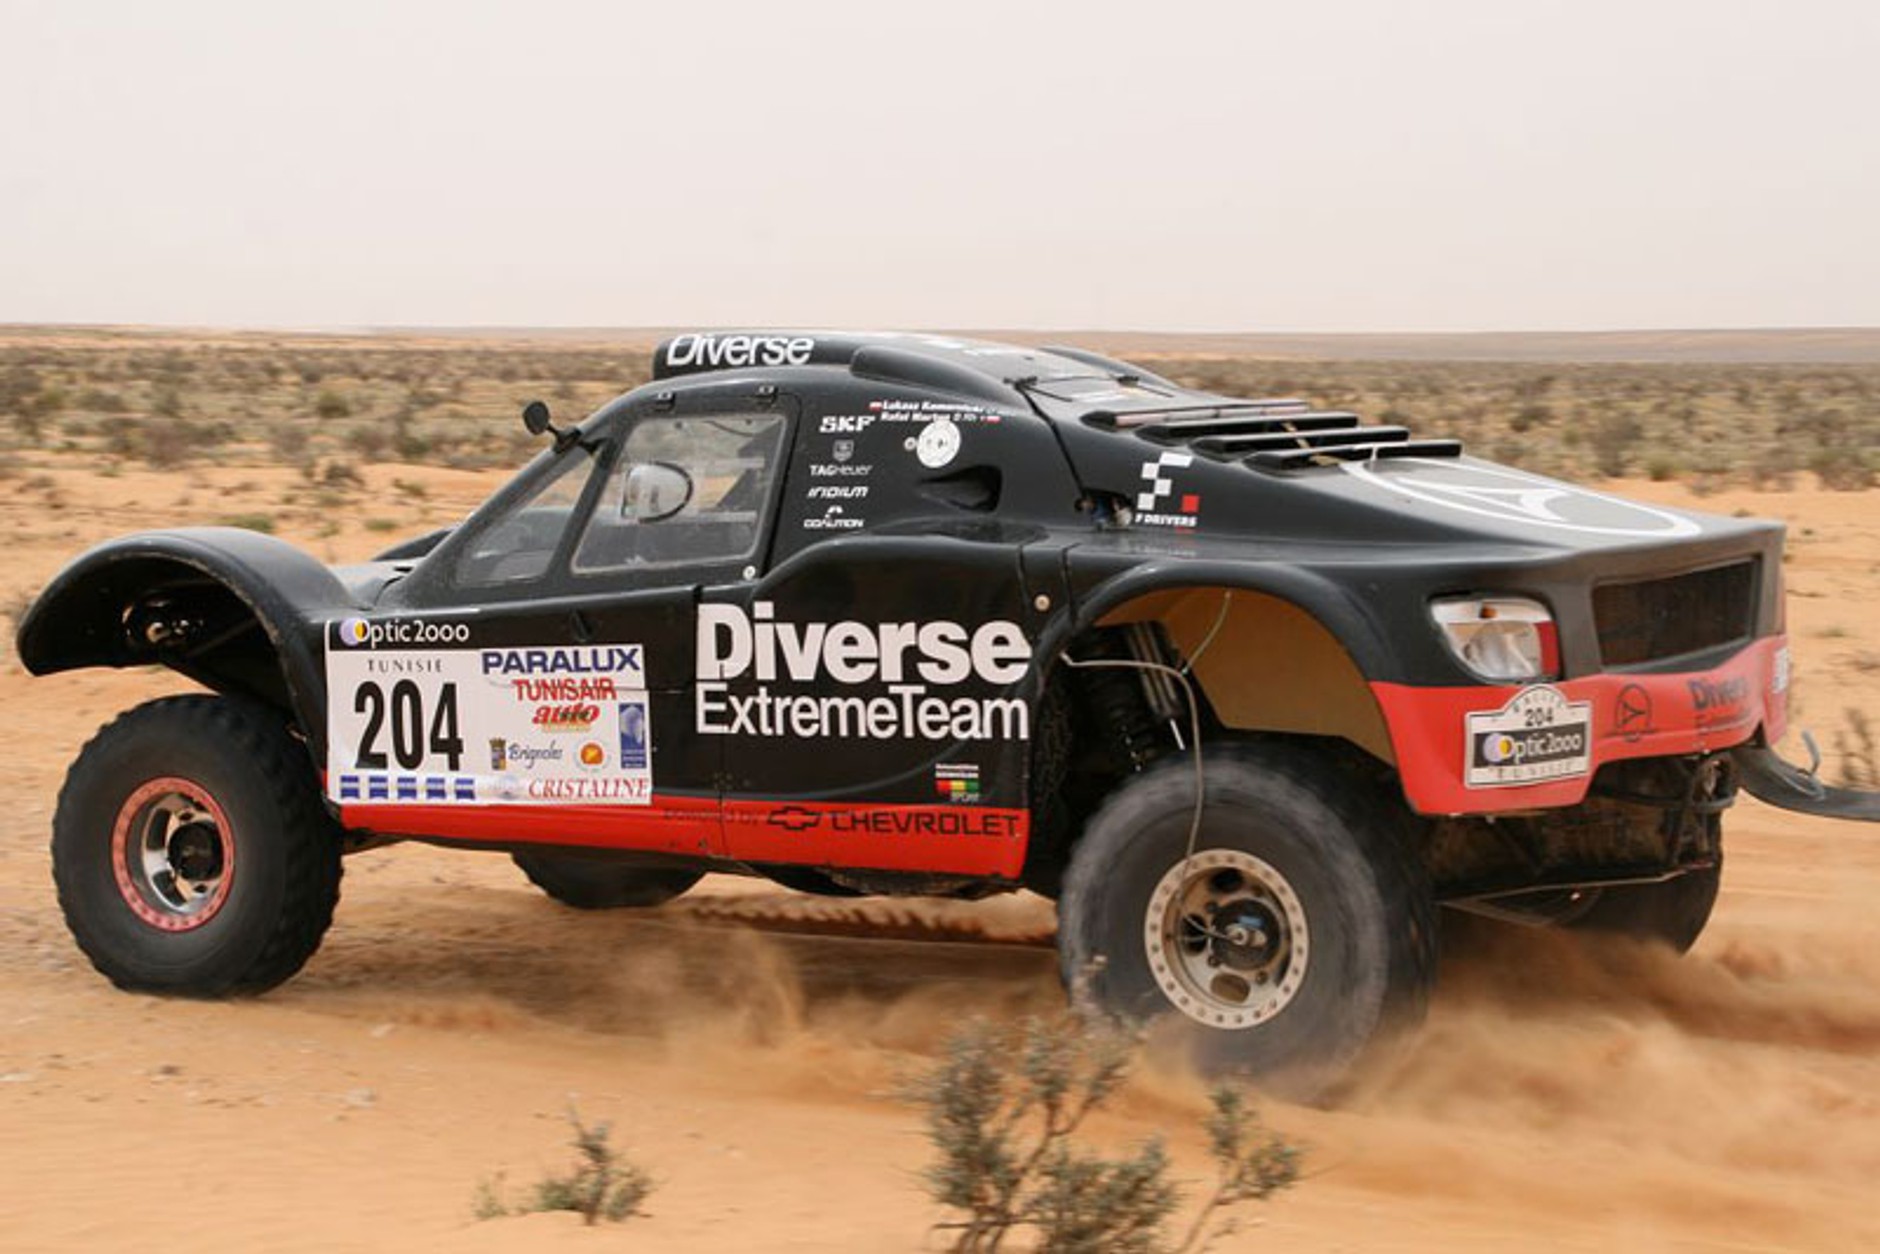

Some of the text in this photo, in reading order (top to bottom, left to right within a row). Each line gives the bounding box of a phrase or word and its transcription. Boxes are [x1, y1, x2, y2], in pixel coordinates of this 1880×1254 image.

[666, 334, 814, 367] Diverse
[820, 415, 876, 433] SKF
[1144, 513, 1197, 527] DRIVERS
[697, 601, 1033, 684] Diverse
[368, 659, 443, 673] TUNISIE
[482, 648, 640, 675] PARALUX
[511, 678, 618, 701] TUNISAIR
[696, 682, 1030, 741] ExtremeTeam
[1525, 707, 1554, 727] 204
[354, 678, 464, 772] 204
[528, 777, 649, 799] CRISTALINE
[830, 810, 1020, 837] CHEVROLET
